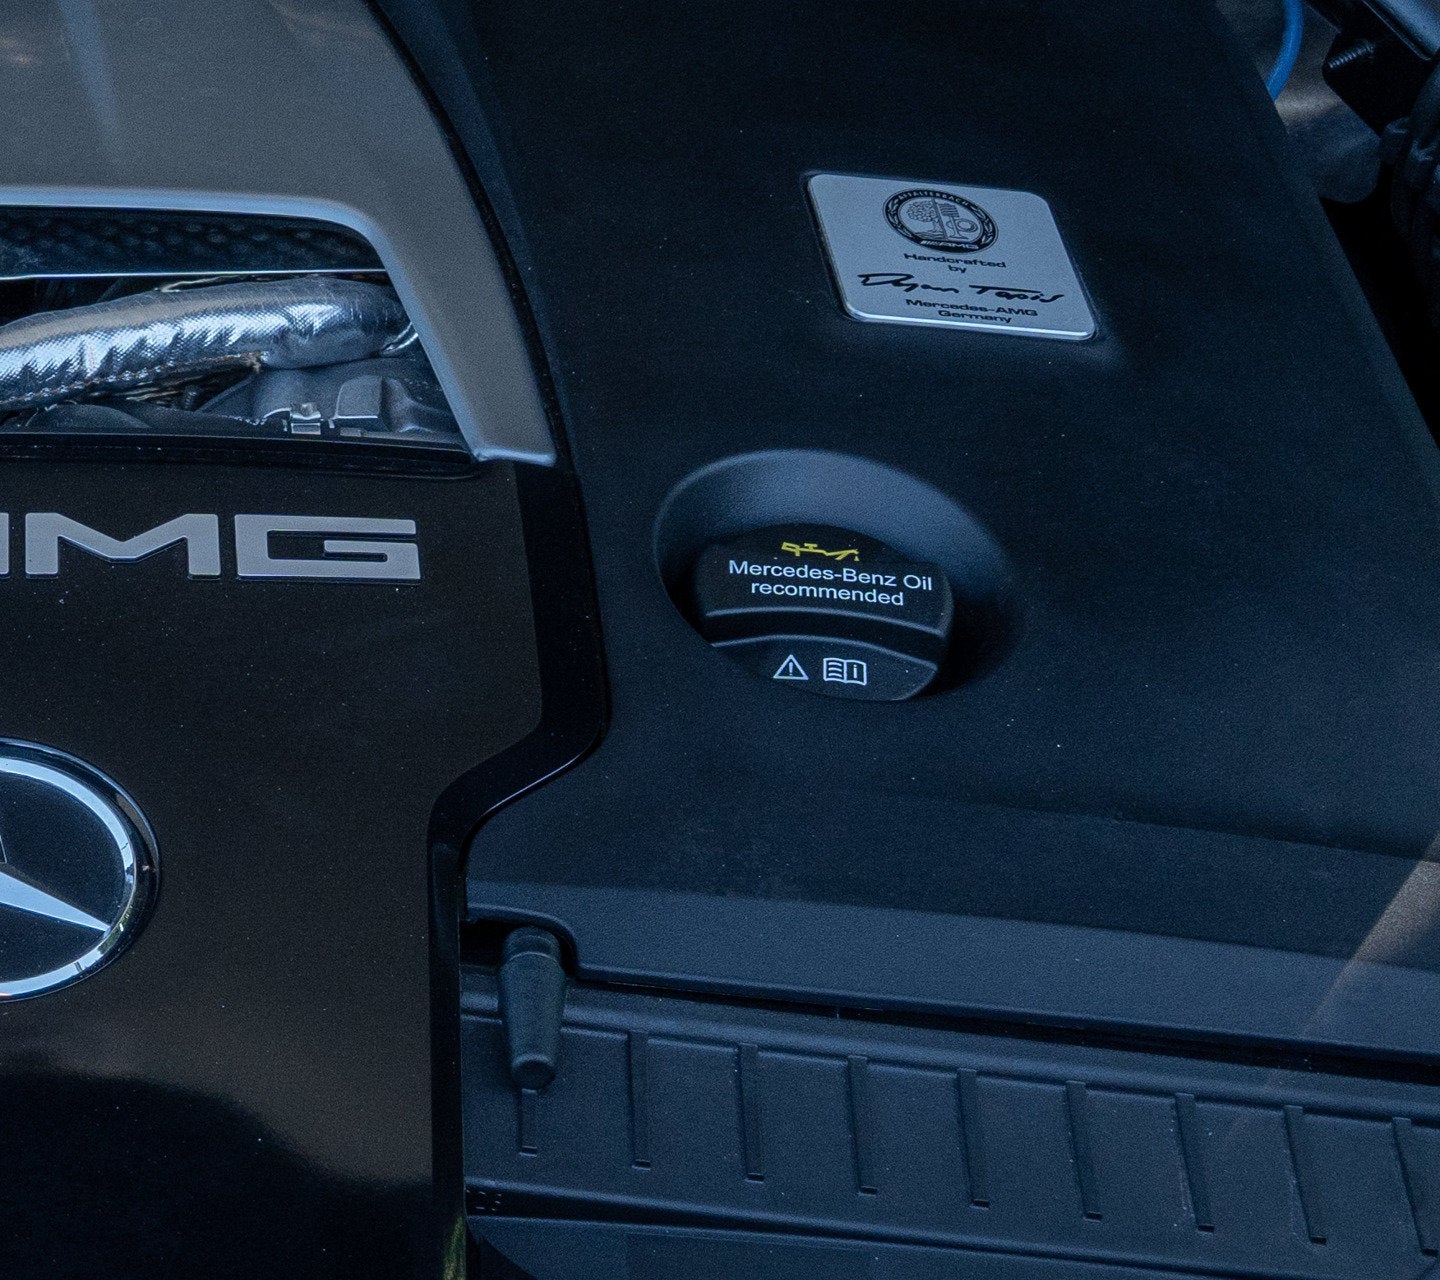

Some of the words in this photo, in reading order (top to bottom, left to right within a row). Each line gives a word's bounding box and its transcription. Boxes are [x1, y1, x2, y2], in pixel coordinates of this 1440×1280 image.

[903, 252, 1007, 269] Handcrafted
[947, 264, 967, 274] by
[906, 298, 1039, 317] Mercedes-AMG
[938, 309, 1012, 324] Germany
[728, 559, 897, 587] Mercedes-Benz
[903, 573, 933, 592] Oil
[750, 580, 904, 606] recommended
